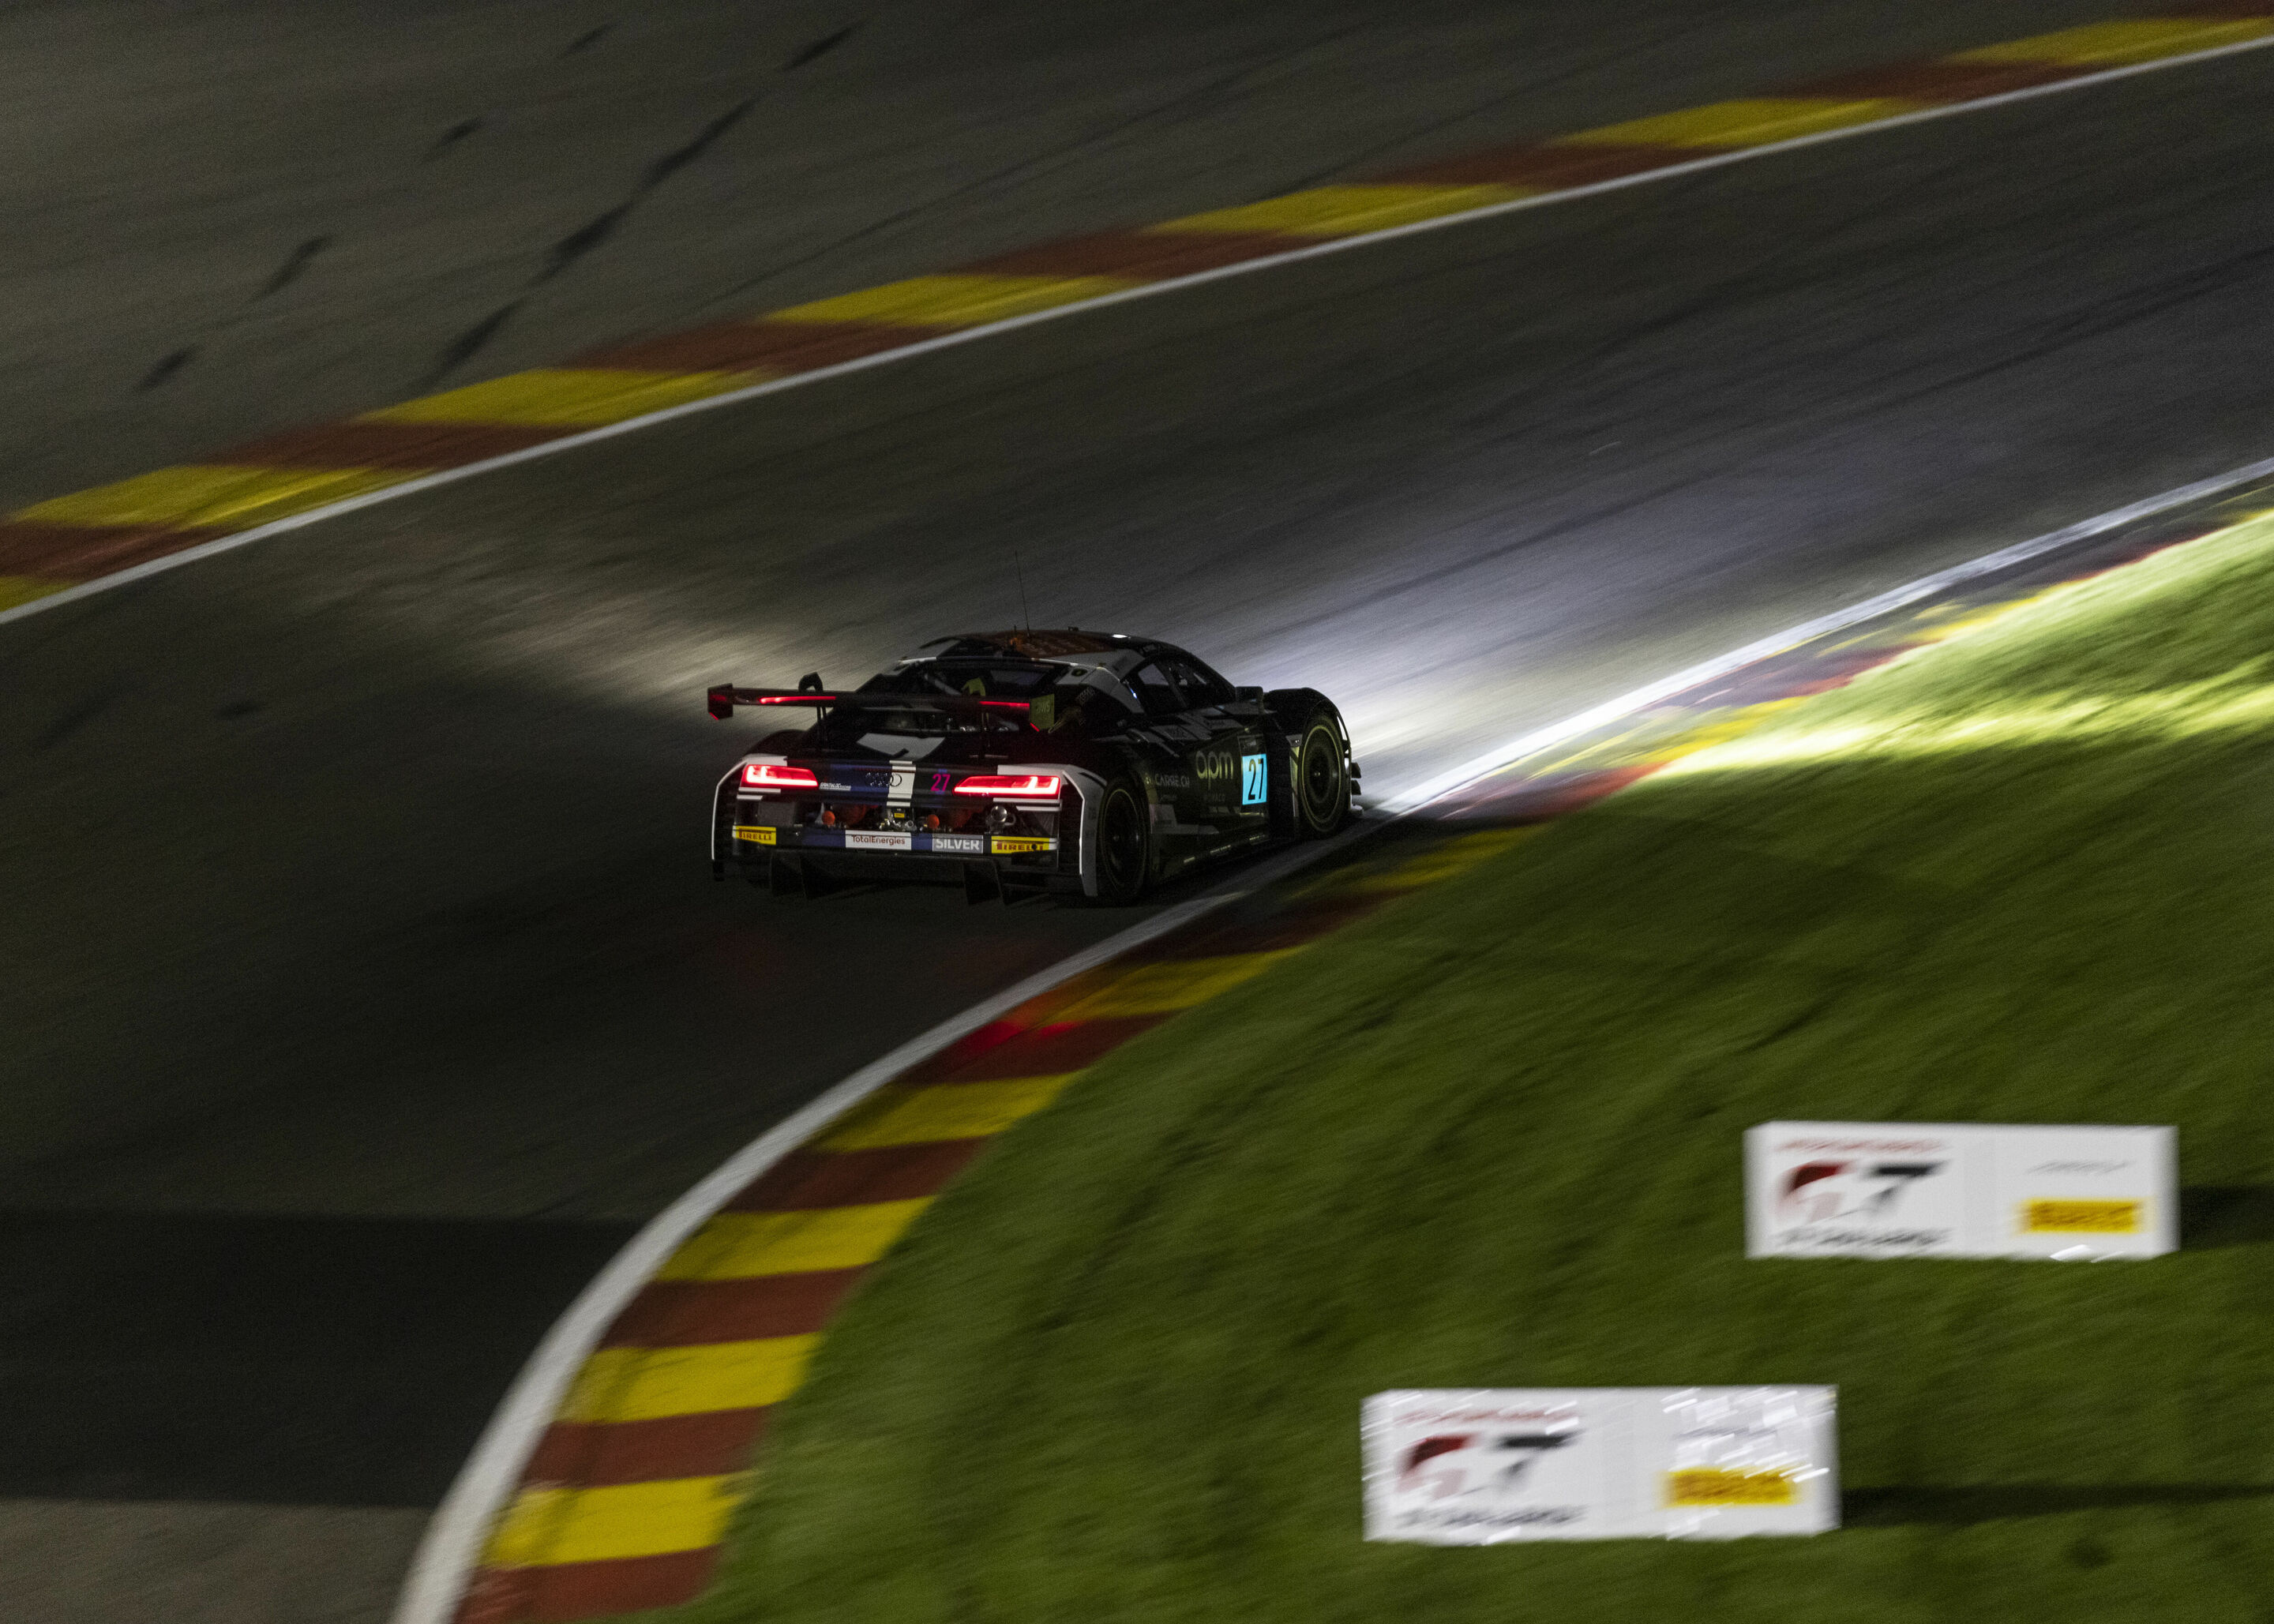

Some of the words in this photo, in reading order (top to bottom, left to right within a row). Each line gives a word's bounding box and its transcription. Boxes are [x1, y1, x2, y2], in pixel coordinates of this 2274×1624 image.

[1195, 750, 1234, 790] apm
[931, 773, 951, 792] 27
[1248, 758, 1264, 800] 27
[738, 827, 771, 841] PIRELLI
[851, 835, 906, 846] TotalEnergies
[936, 838, 980, 850] SILVER
